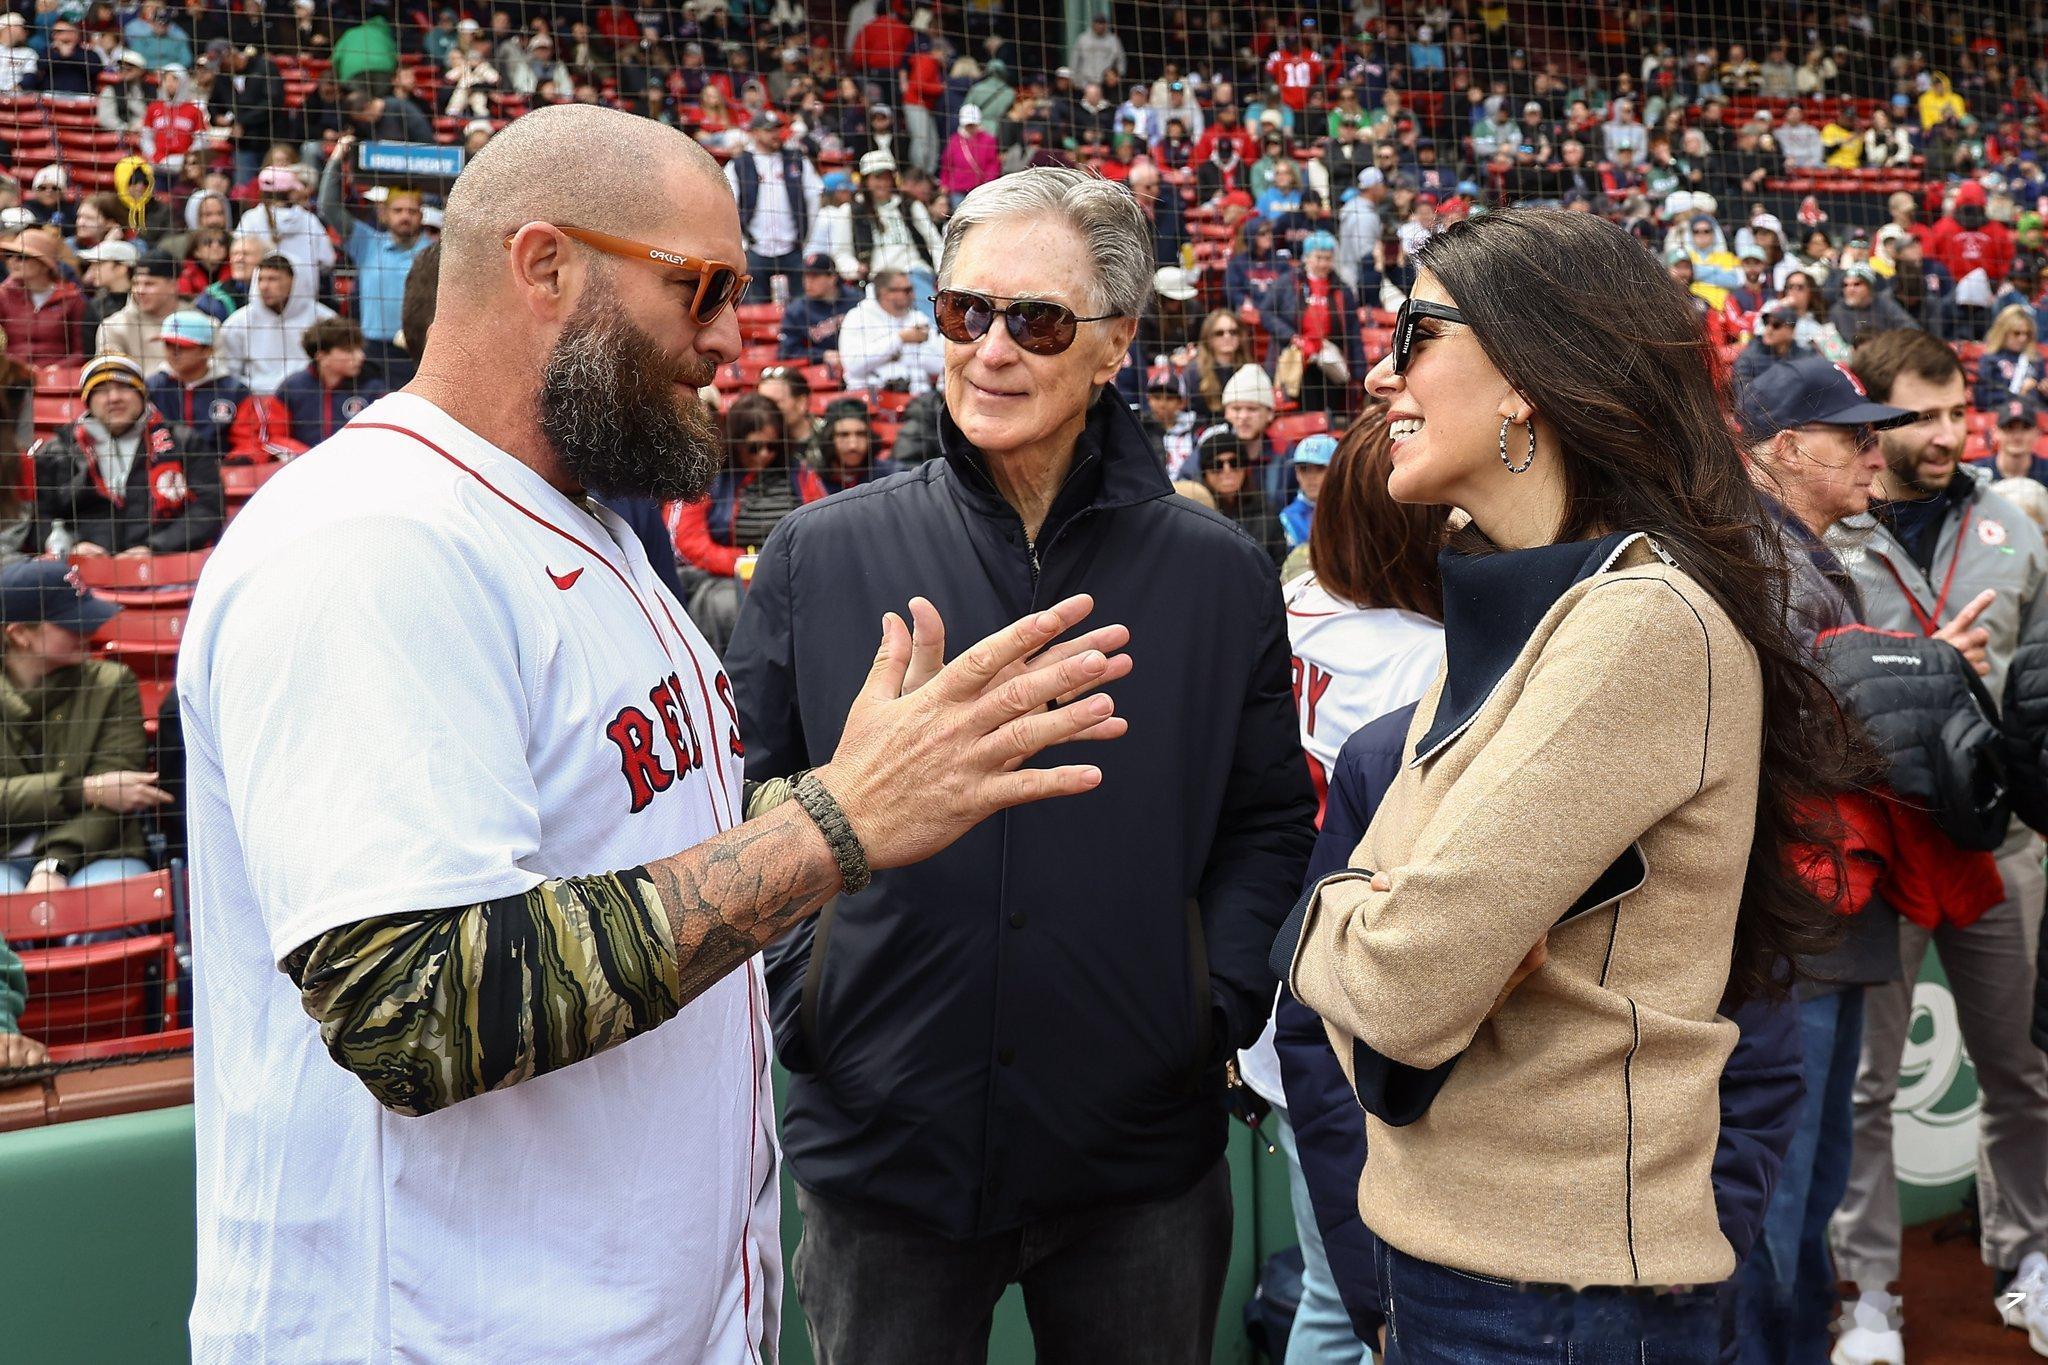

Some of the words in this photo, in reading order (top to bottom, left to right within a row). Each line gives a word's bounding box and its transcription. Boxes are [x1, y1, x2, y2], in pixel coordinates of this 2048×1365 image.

[1284, 62, 1310, 87] 10
[649, 250, 688, 265] OAKLEY
[1402, 323, 1413, 354] BALENCIAGA
